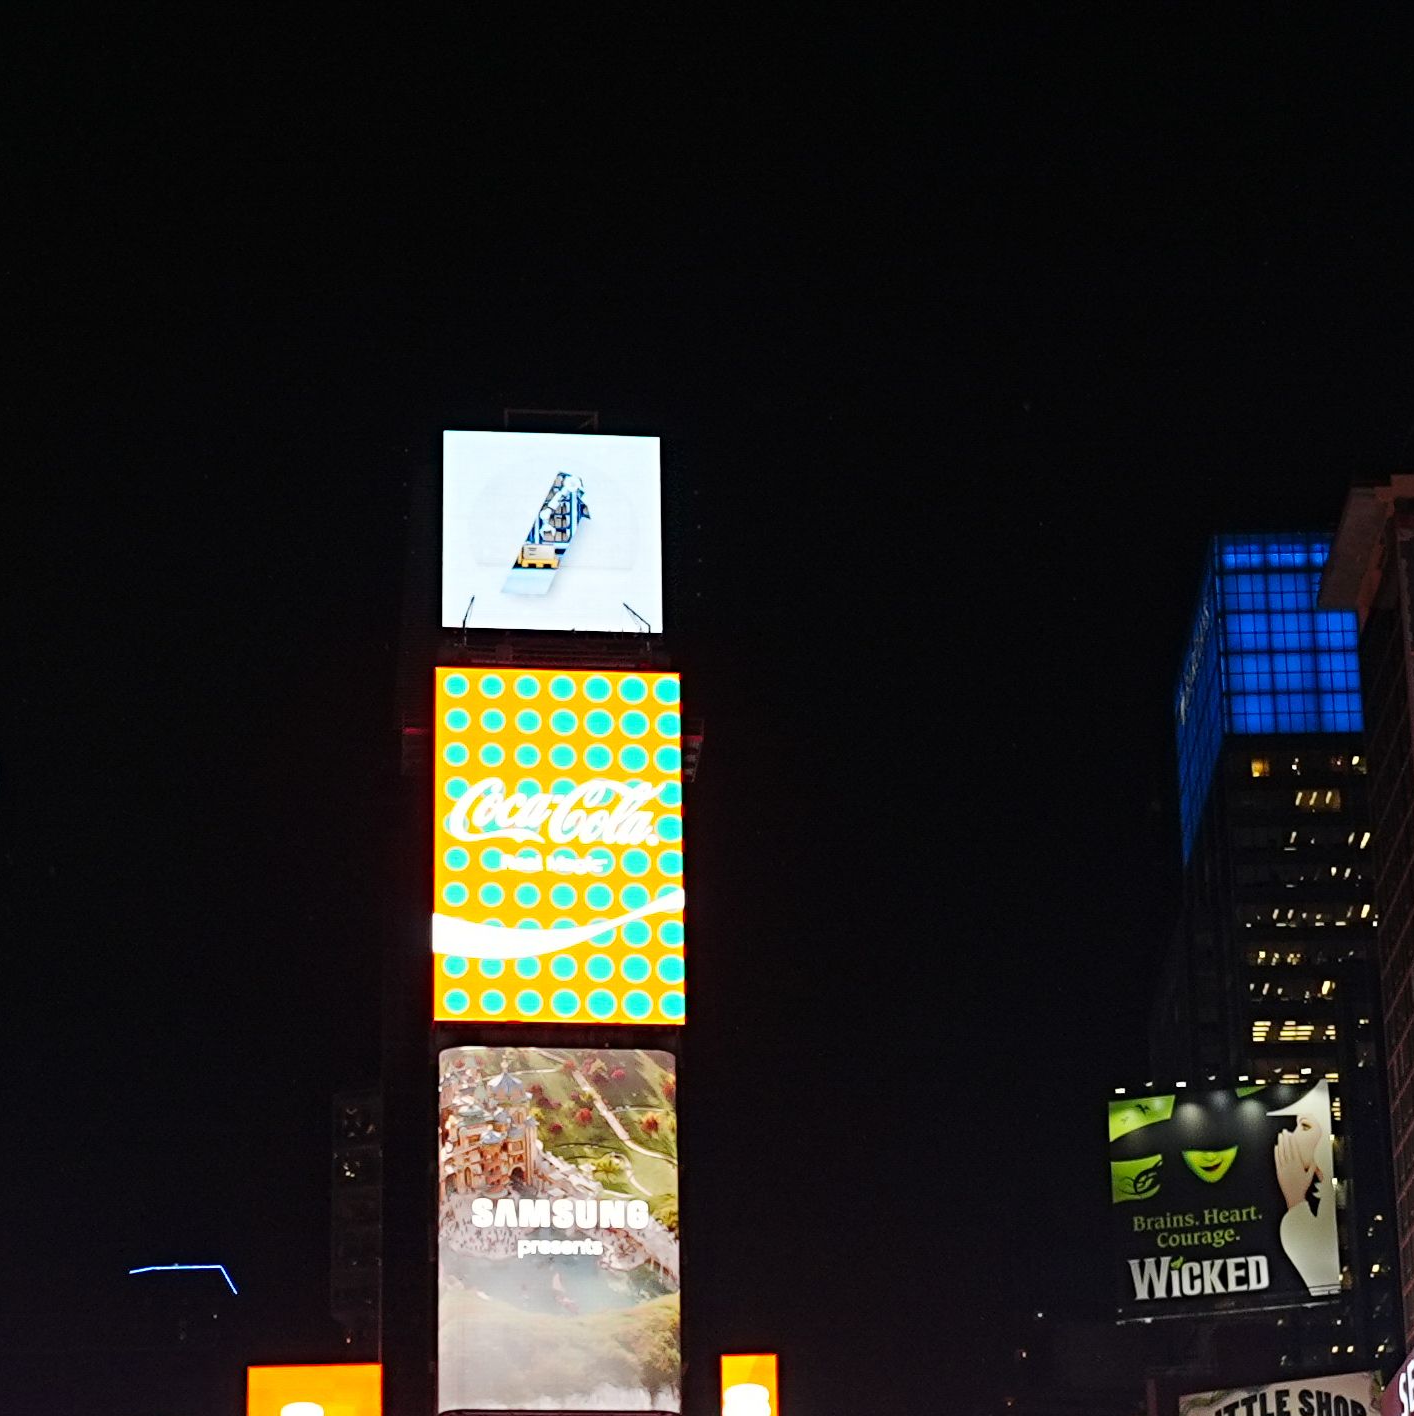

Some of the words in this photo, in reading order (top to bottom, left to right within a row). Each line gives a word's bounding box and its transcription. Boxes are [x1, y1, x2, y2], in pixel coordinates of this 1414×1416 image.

[471, 1197, 649, 1229] SAMSUNG
[1133, 1212, 1199, 1231] Brains.
[1204, 1206, 1262, 1224] Heart.
[517, 1238, 604, 1258] presents
[1157, 1228, 1240, 1248] Courage.
